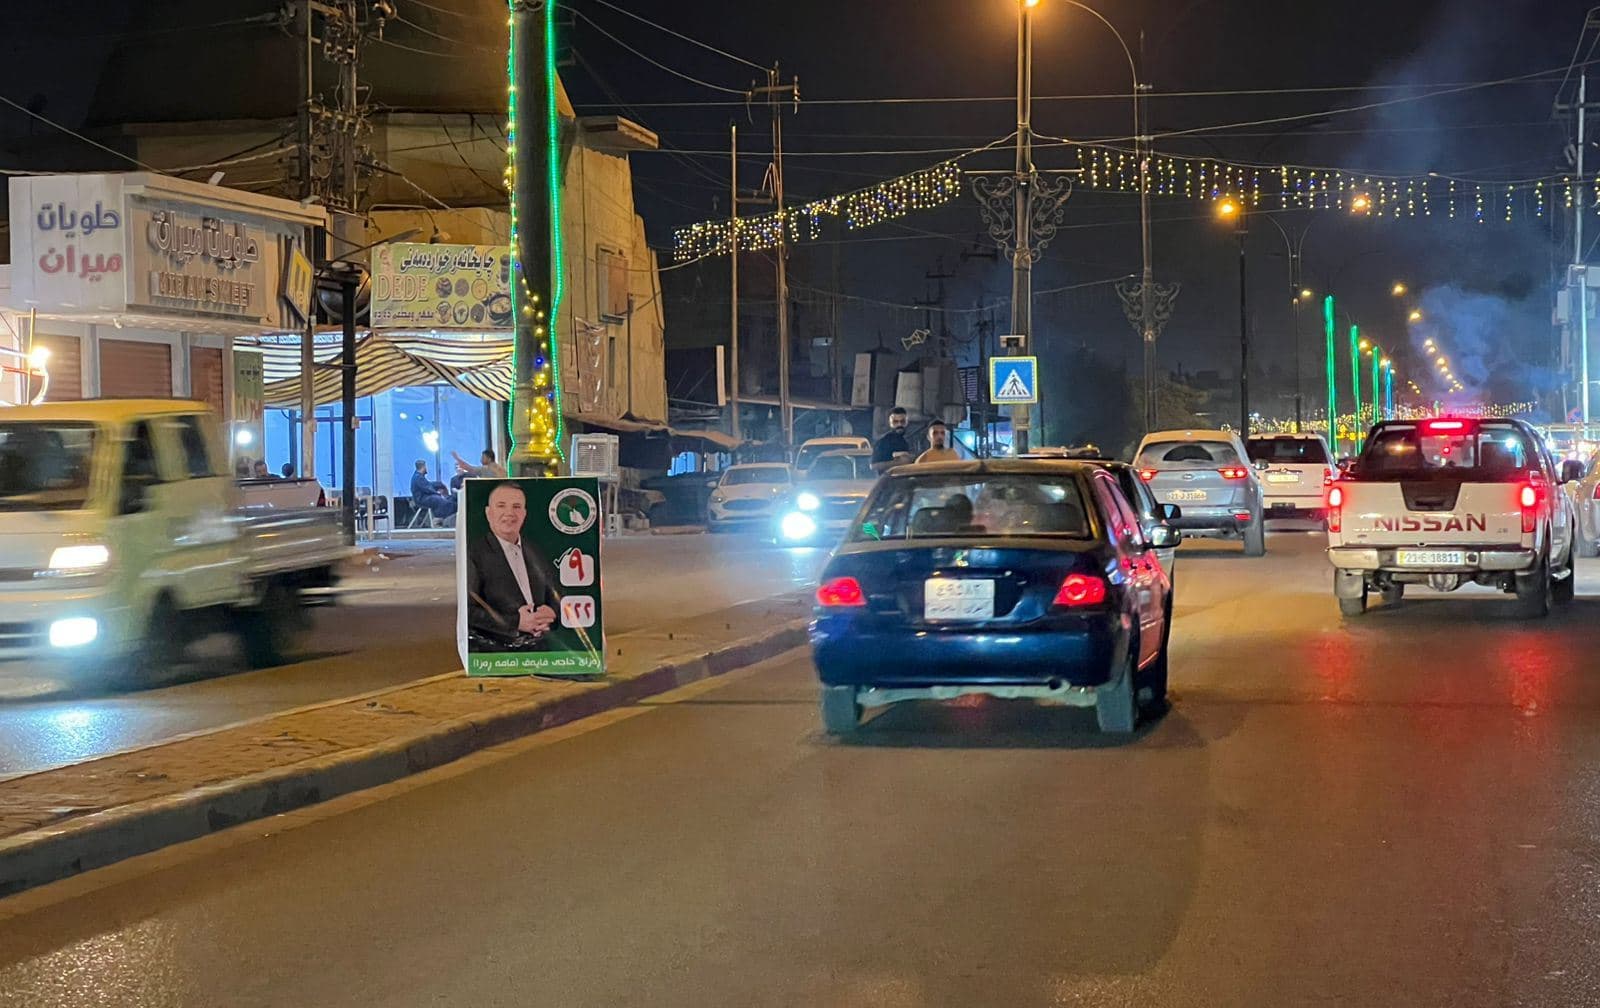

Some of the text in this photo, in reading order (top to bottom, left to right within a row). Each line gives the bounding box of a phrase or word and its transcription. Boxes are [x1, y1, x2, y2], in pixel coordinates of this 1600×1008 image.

[37, 200, 120, 238] حلويات
[153, 210, 260, 269] حلويات ميران
[39, 244, 122, 282] ميران
[153, 271, 207, 301] MIRAN
[207, 277, 257, 307] SWEET
[376, 274, 429, 302] DEDE
[1374, 513, 1486, 532] NISSAN
[568, 547, 585, 582] ٩
[563, 601, 592, 621] ٢٢٢
